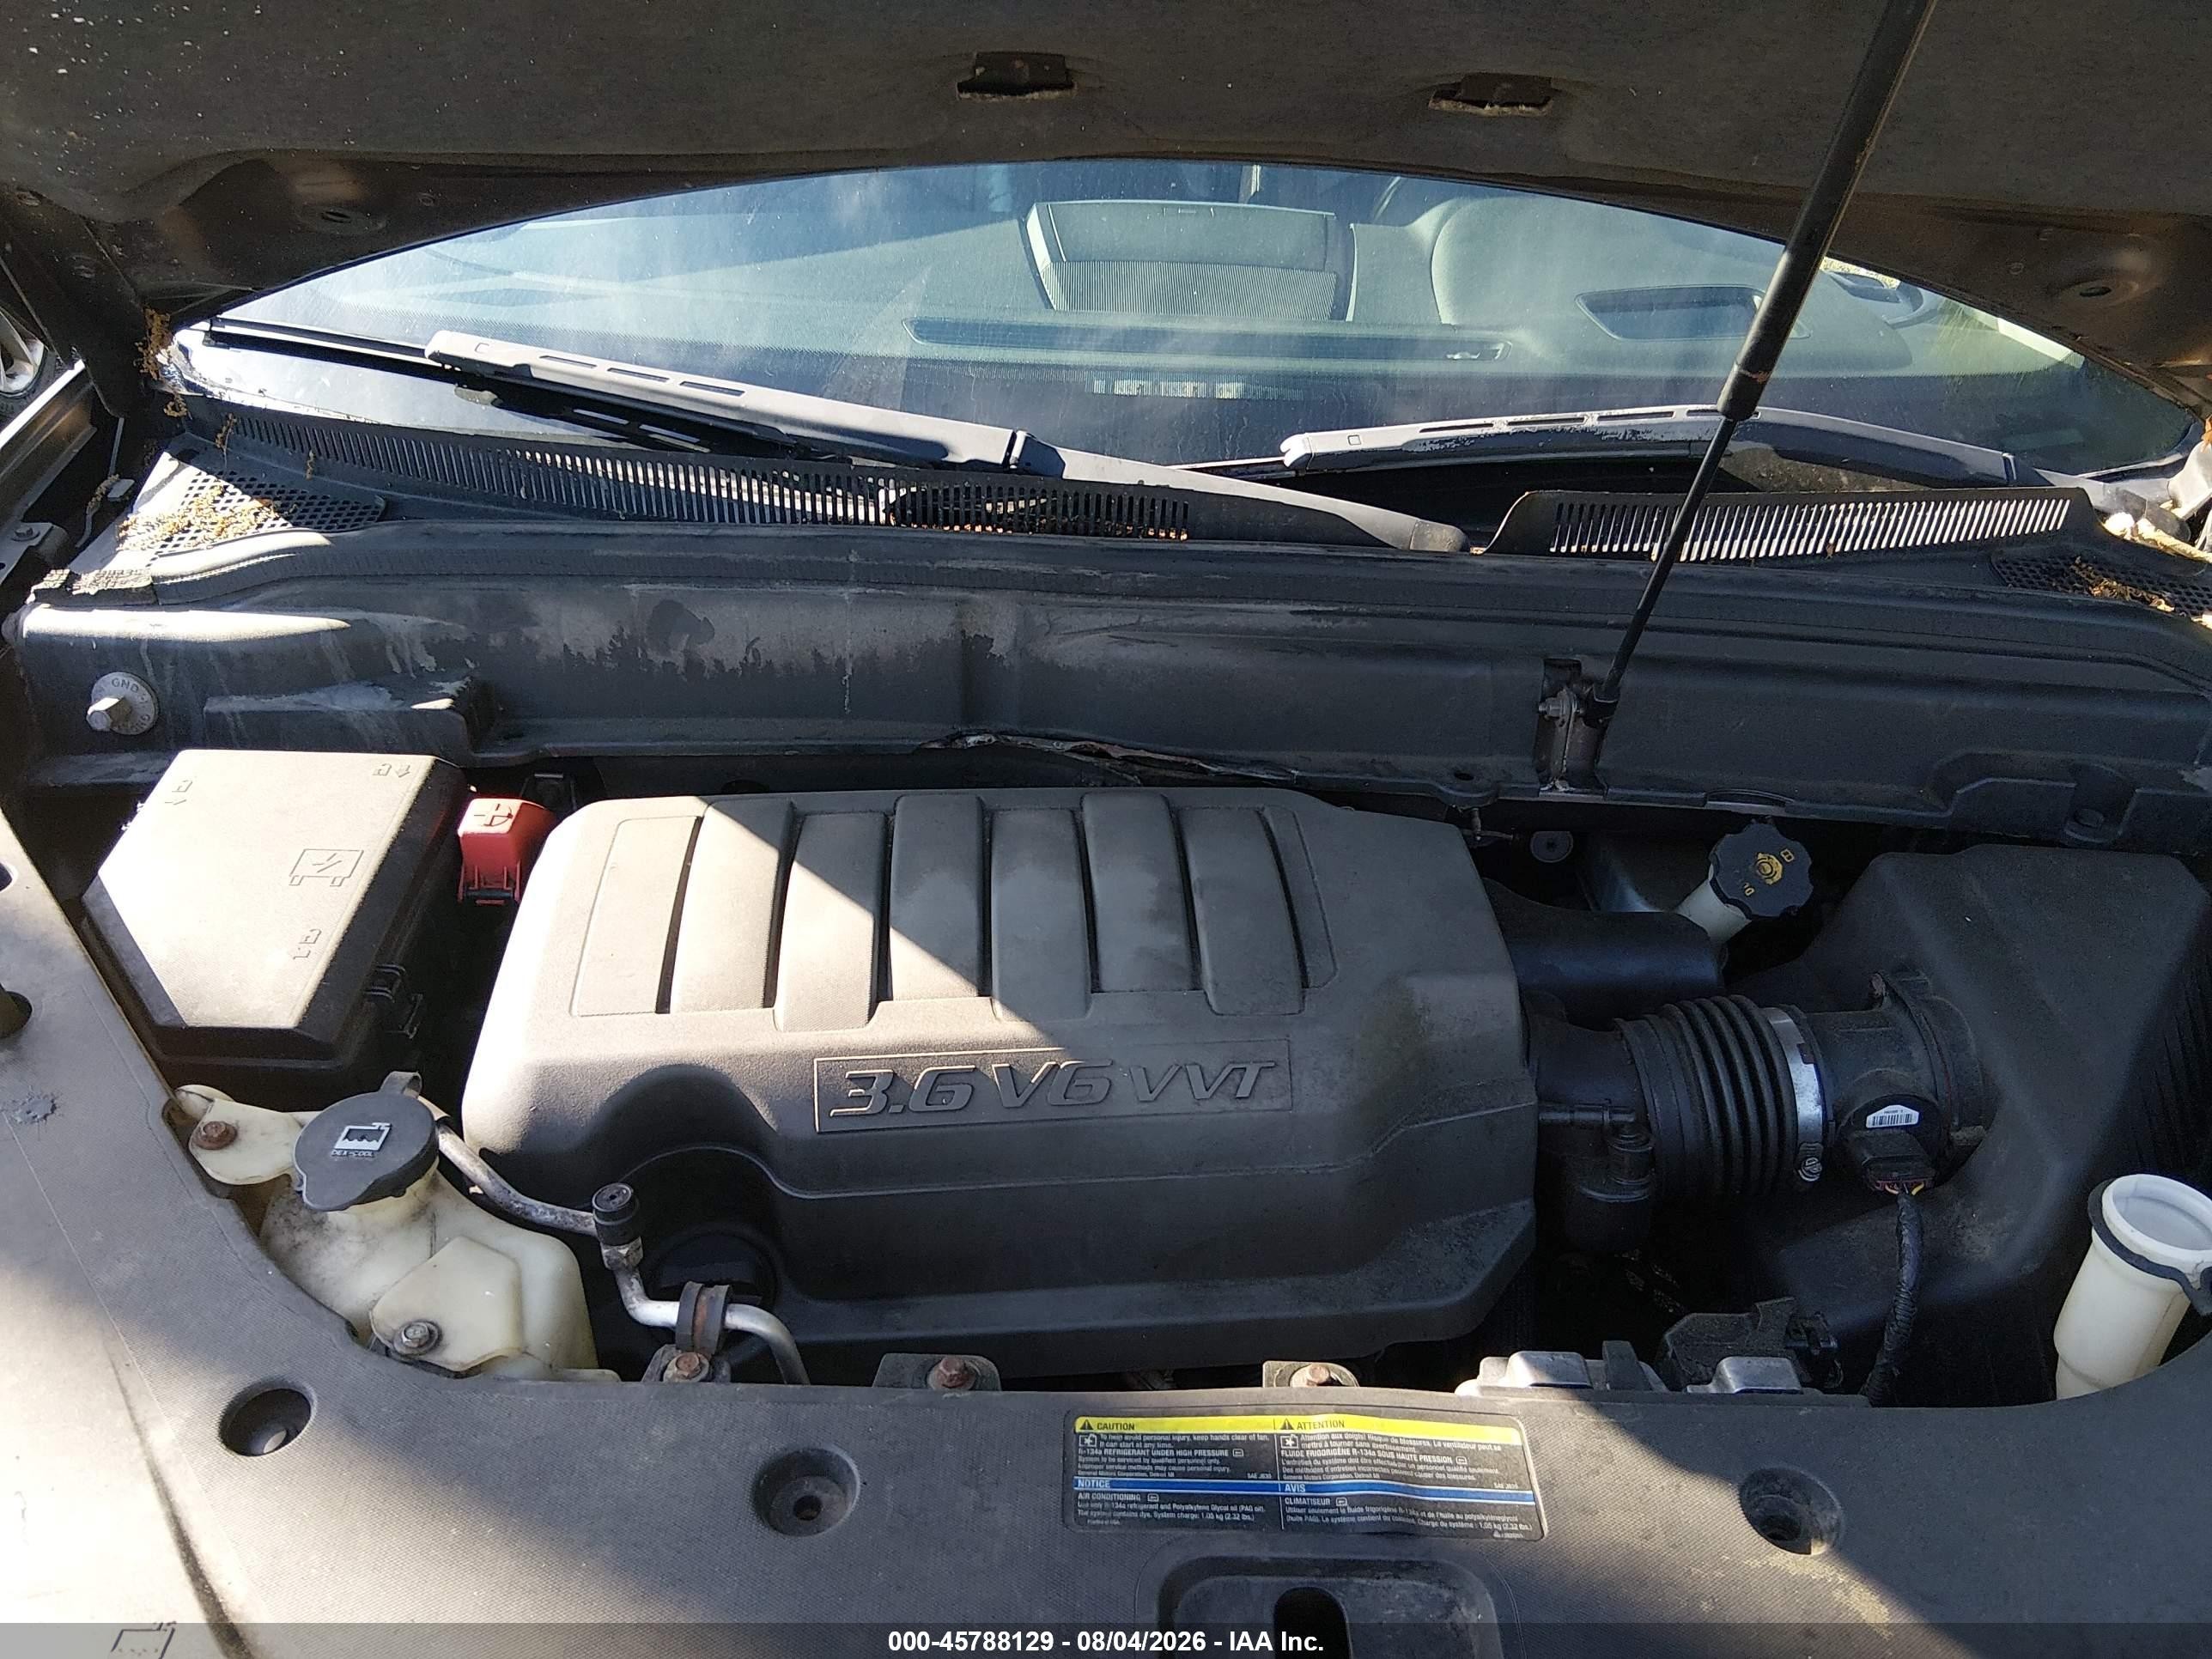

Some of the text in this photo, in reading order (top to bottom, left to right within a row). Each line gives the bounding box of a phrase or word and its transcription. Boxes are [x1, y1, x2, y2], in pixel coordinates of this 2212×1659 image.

[112, 678, 139, 694] GND
[829, 1058, 1276, 1117] 3.6 V6 VVT
[331, 1149, 376, 1158] DEX-COOL
[1097, 1422, 1135, 1431] CAUTION
[1297, 1419, 1346, 1431] ATTENTION
[1396, 1452, 1419, 1462] HAUTE
[1419, 1454, 1453, 1464] PRESSION
[1078, 1480, 1111, 1488] NOTICE
[1285, 1484, 1306, 1492] AVIS
[1091, 1493, 1141, 1502] CONDITIONING
[1285, 1497, 1331, 1505] CLIMATISEUR
[1215, 1512, 1224, 1522] kg
[1493, 1522, 1502, 1531] kg
